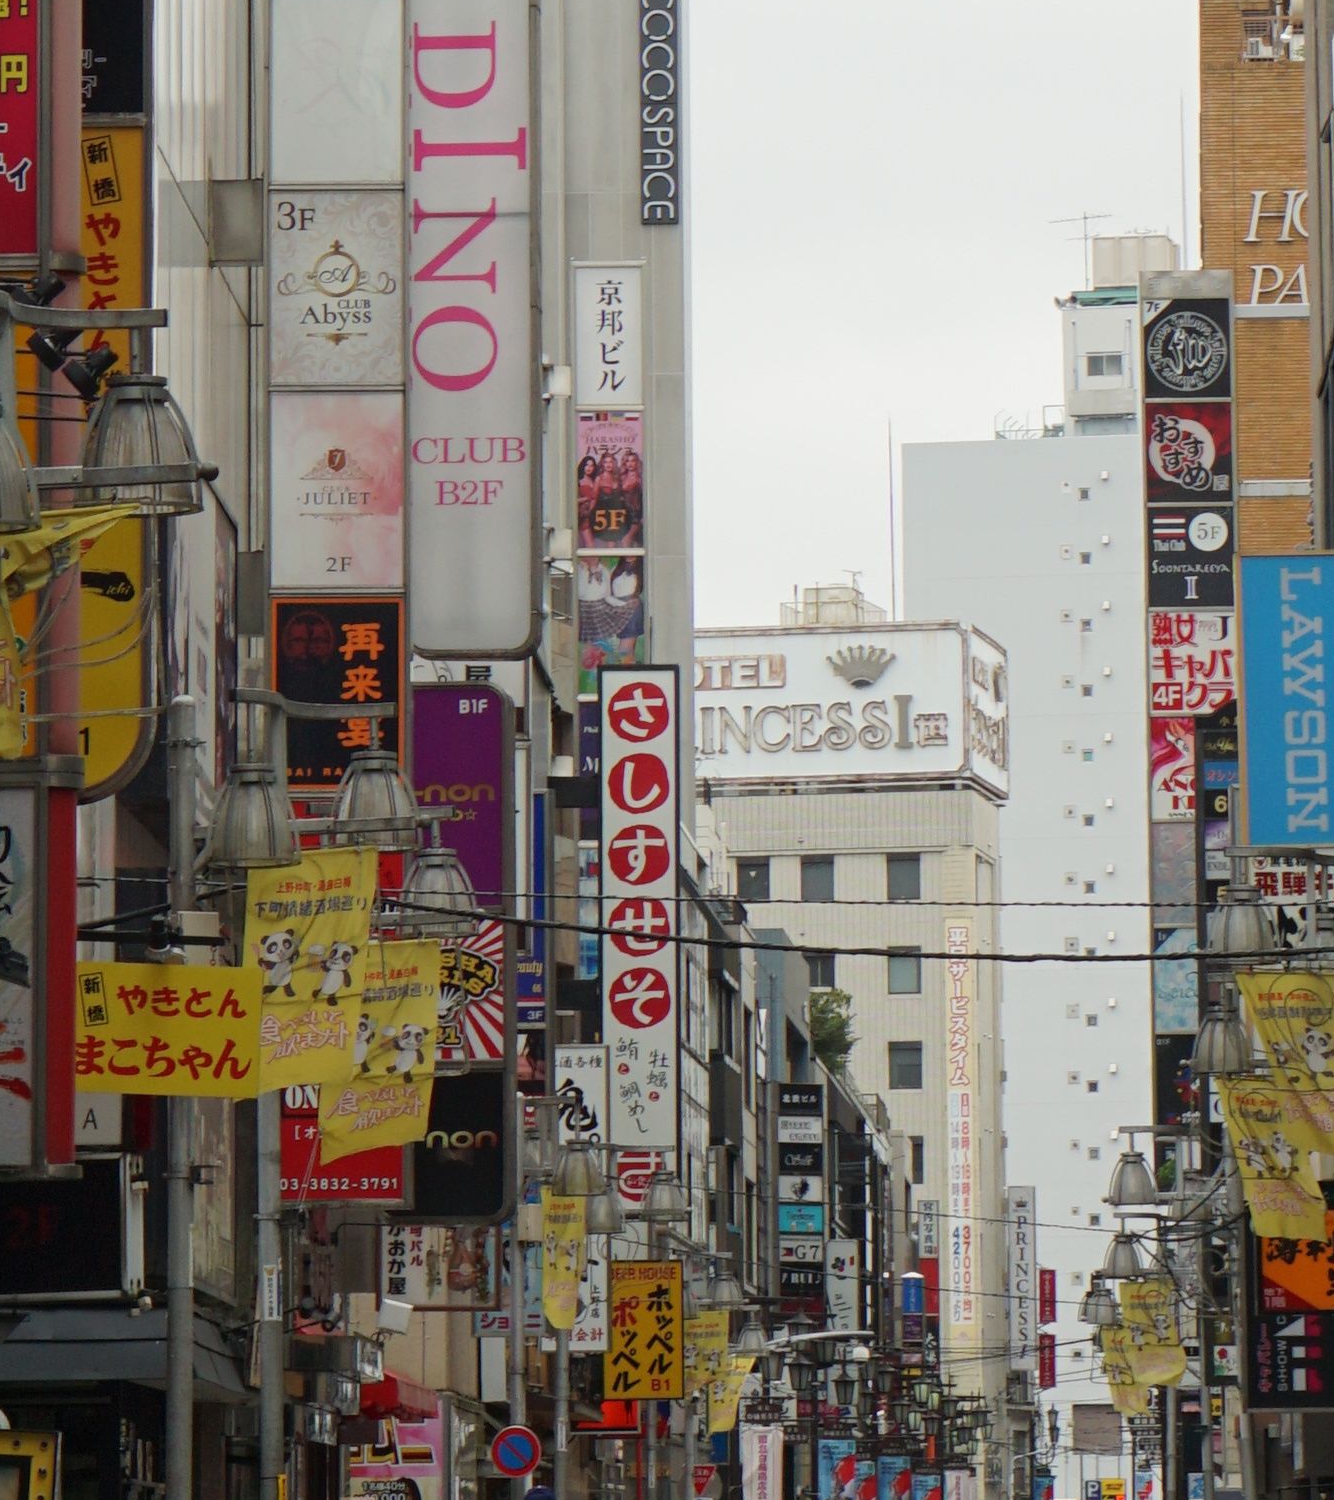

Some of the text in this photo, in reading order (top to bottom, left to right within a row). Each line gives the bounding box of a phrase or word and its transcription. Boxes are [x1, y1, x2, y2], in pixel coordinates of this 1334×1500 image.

[86, 142, 117, 200] 新橋
[276, 201, 316, 232] 3F
[413, 19, 527, 392] DINO
[299, 301, 373, 331] Abyss
[336, 299, 371, 310] CLUB
[1144, 301, 1161, 313] 7F
[593, 279, 625, 393] 京邦ビル
[412, 436, 527, 464] CLUB
[302, 491, 371, 506] JULIET
[434, 480, 504, 507] B2F
[592, 508, 628, 531] 5F
[1196, 522, 1221, 540] 5F
[326, 557, 353, 573] 2F
[1151, 612, 1196, 647] 熟女
[458, 699, 489, 714] B1F
[1153, 681, 1236, 712] 4F クラ
[1279, 566, 1329, 833] LAWSON
[609, 684, 670, 1028] さしすせそ
[82, 976, 248, 1025] 新橋 やきとん
[526, 1009, 544, 1021] 3F
[75, 1034, 253, 1082] まこちゃん
[279, 1176, 399, 1191] 03-3832-3791
[794, 1244, 820, 1260] G7
[638, 1267, 677, 1281] HOUSE
[1014, 1215, 1029, 1343] PRINCESS
[651, 1379, 671, 1391] B1
